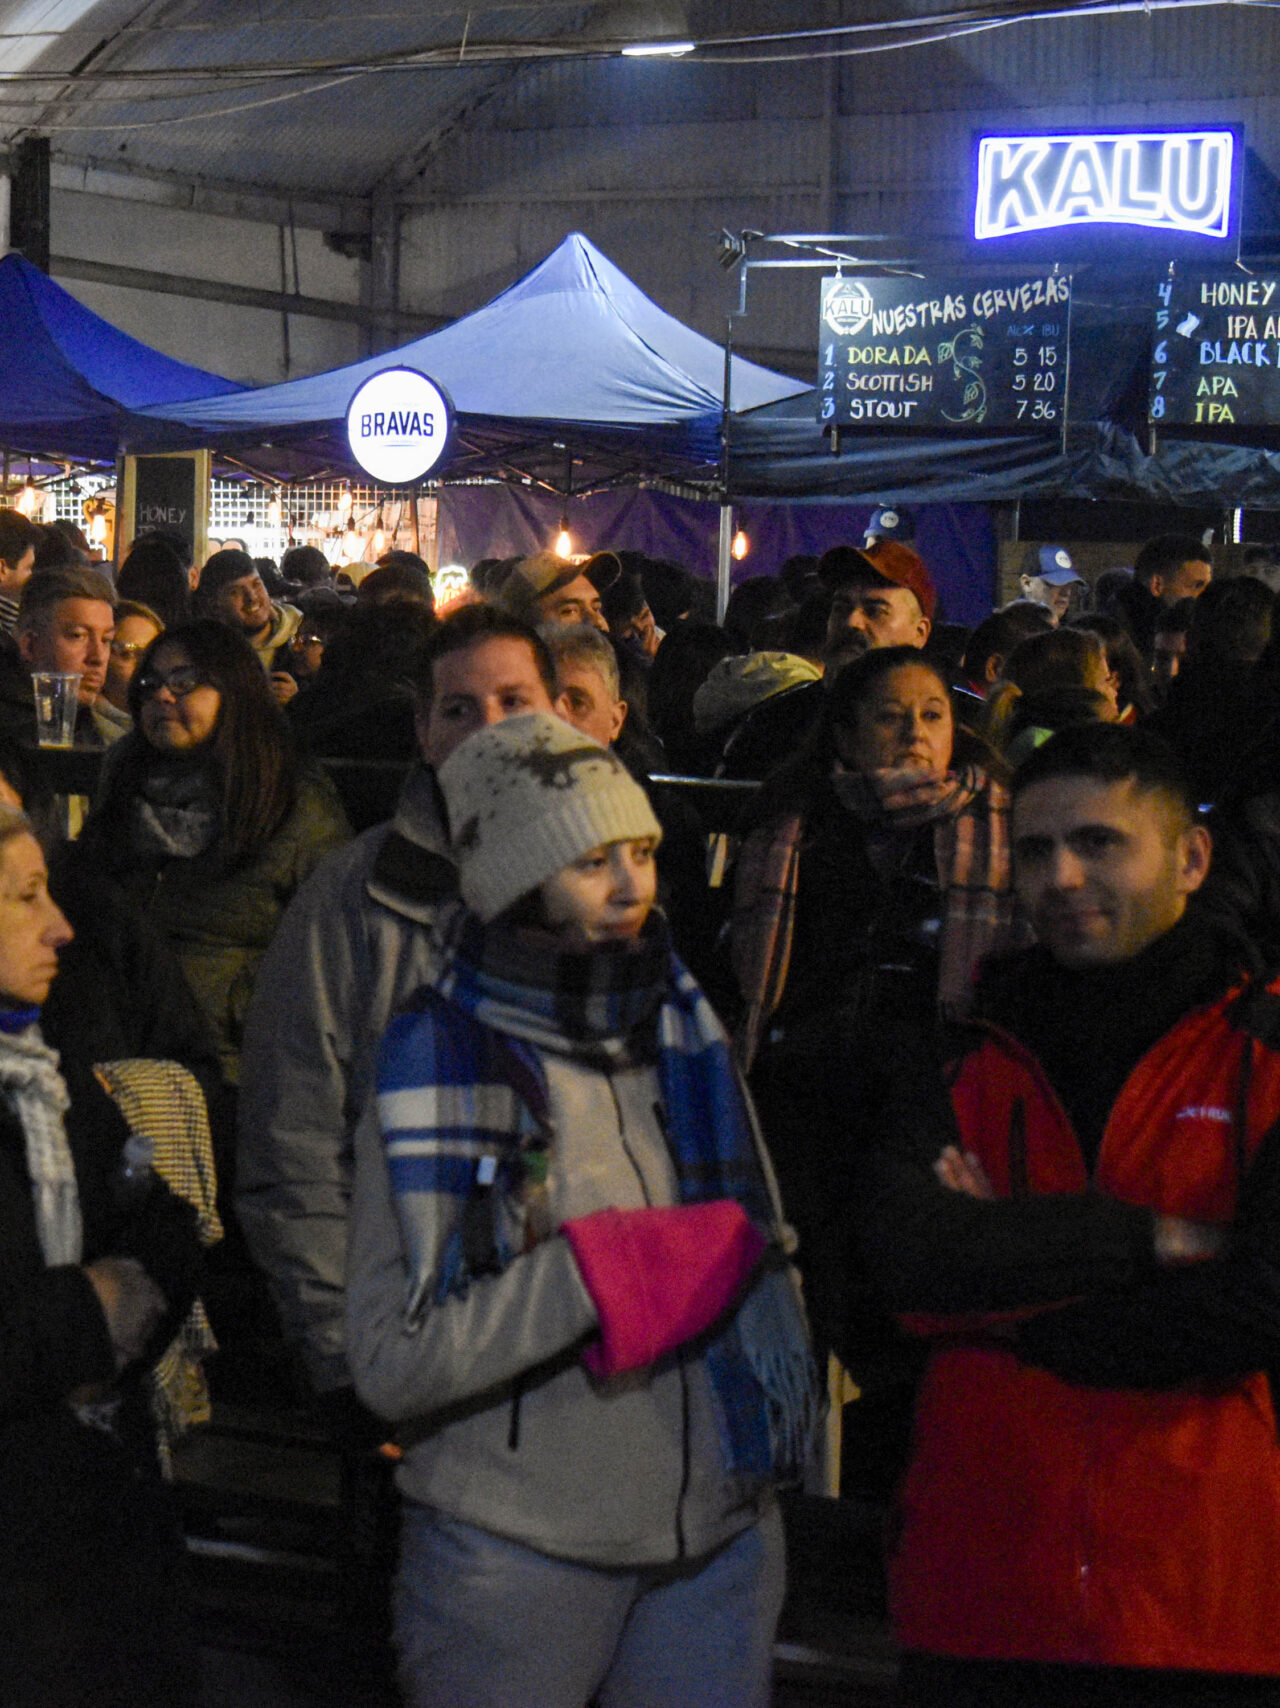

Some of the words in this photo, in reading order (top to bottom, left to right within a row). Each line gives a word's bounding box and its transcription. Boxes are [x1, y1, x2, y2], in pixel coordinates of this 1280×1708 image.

[981, 137, 1226, 232] KALU
[872, 295, 967, 336] NUESTRAS
[972, 276, 1070, 319] CERVEZAS
[1158, 282, 1172, 306] 4
[1201, 281, 1276, 307] HONEY
[824, 299, 872, 317] KALU
[1156, 310, 1170, 330] 5
[1228, 315, 1258, 339] IPA
[847, 346, 932, 365] DORADA
[1013, 348, 1027, 366] 5
[1039, 347, 1057, 366] 15
[1154, 340, 1168, 364] 6
[1200, 340, 1270, 367] BLACK
[823, 371, 835, 391] 2
[846, 373, 933, 392] SCOTTISH
[1012, 374, 1026, 390] 5
[1033, 371, 1055, 392] 20
[1153, 371, 1167, 390] 7
[1196, 376, 1238, 398] APA
[821, 397, 835, 418] 3
[849, 399, 918, 419] STOUT
[1017, 401, 1029, 419] 7
[1031, 401, 1056, 419] 36
[1151, 395, 1166, 418] 8
[1195, 402, 1235, 423] IPA
[361, 410, 434, 437] BRAVAS
[140, 503, 186, 523] HONEY
